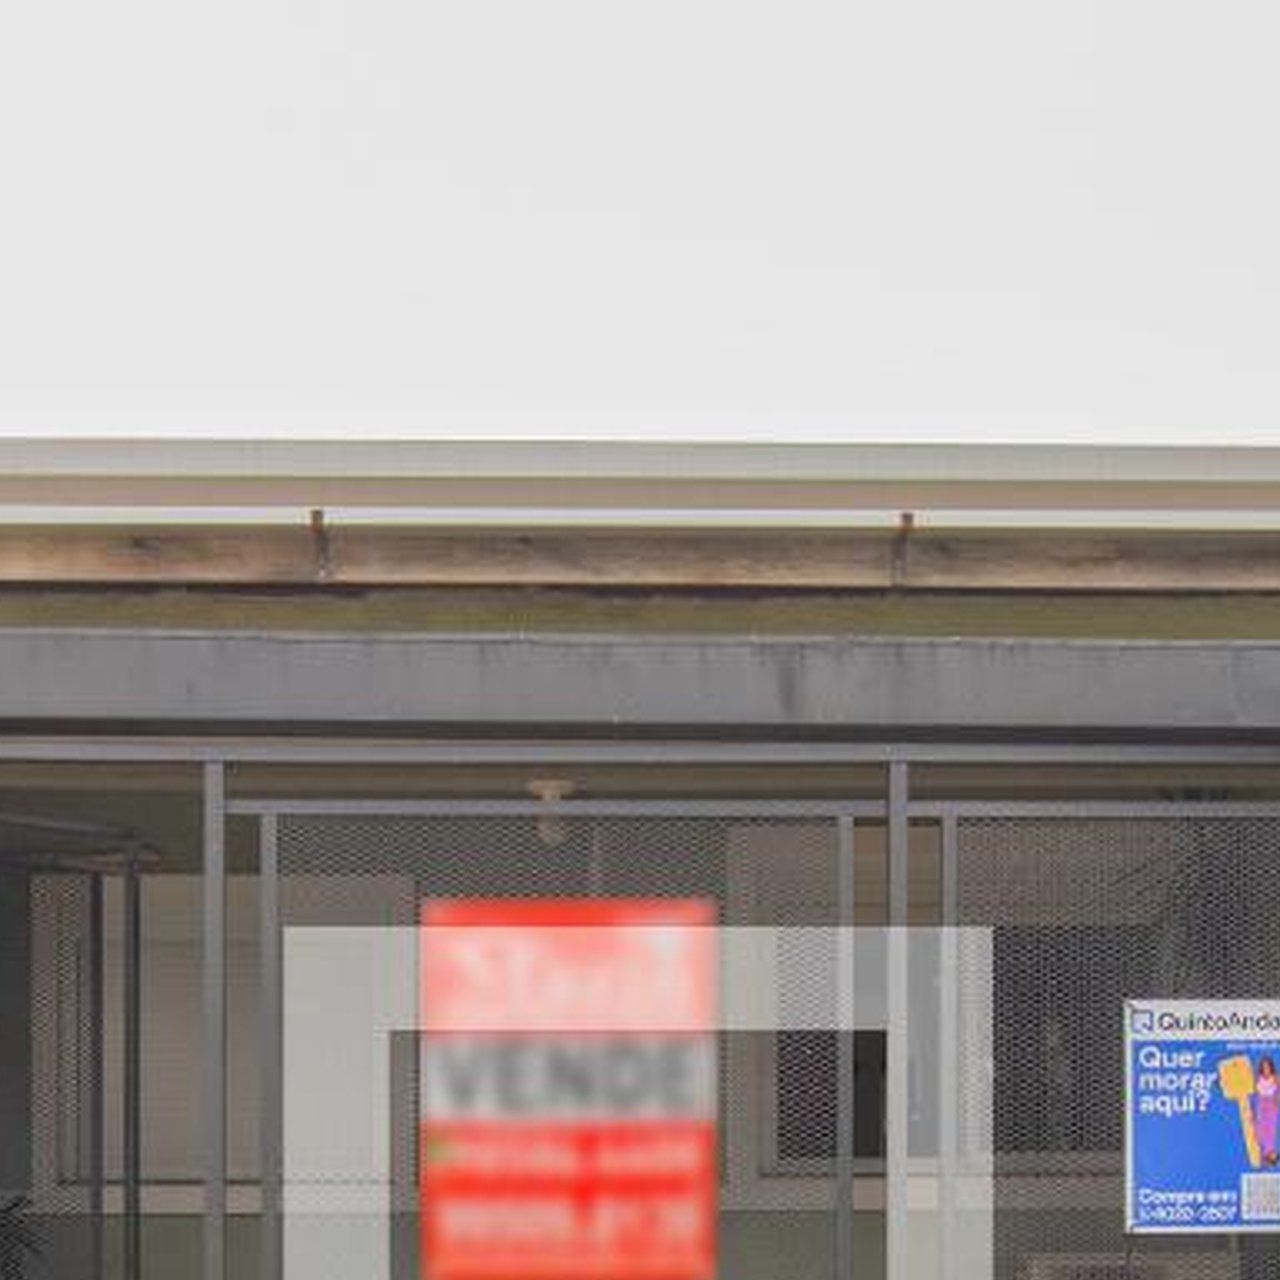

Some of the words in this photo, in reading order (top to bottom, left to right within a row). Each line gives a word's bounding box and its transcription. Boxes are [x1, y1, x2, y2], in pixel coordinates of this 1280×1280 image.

[1139, 1046, 1205, 1068] Quer
[1139, 1072, 1217, 1090] morar
[1139, 1090, 1210, 1117] aqui?
